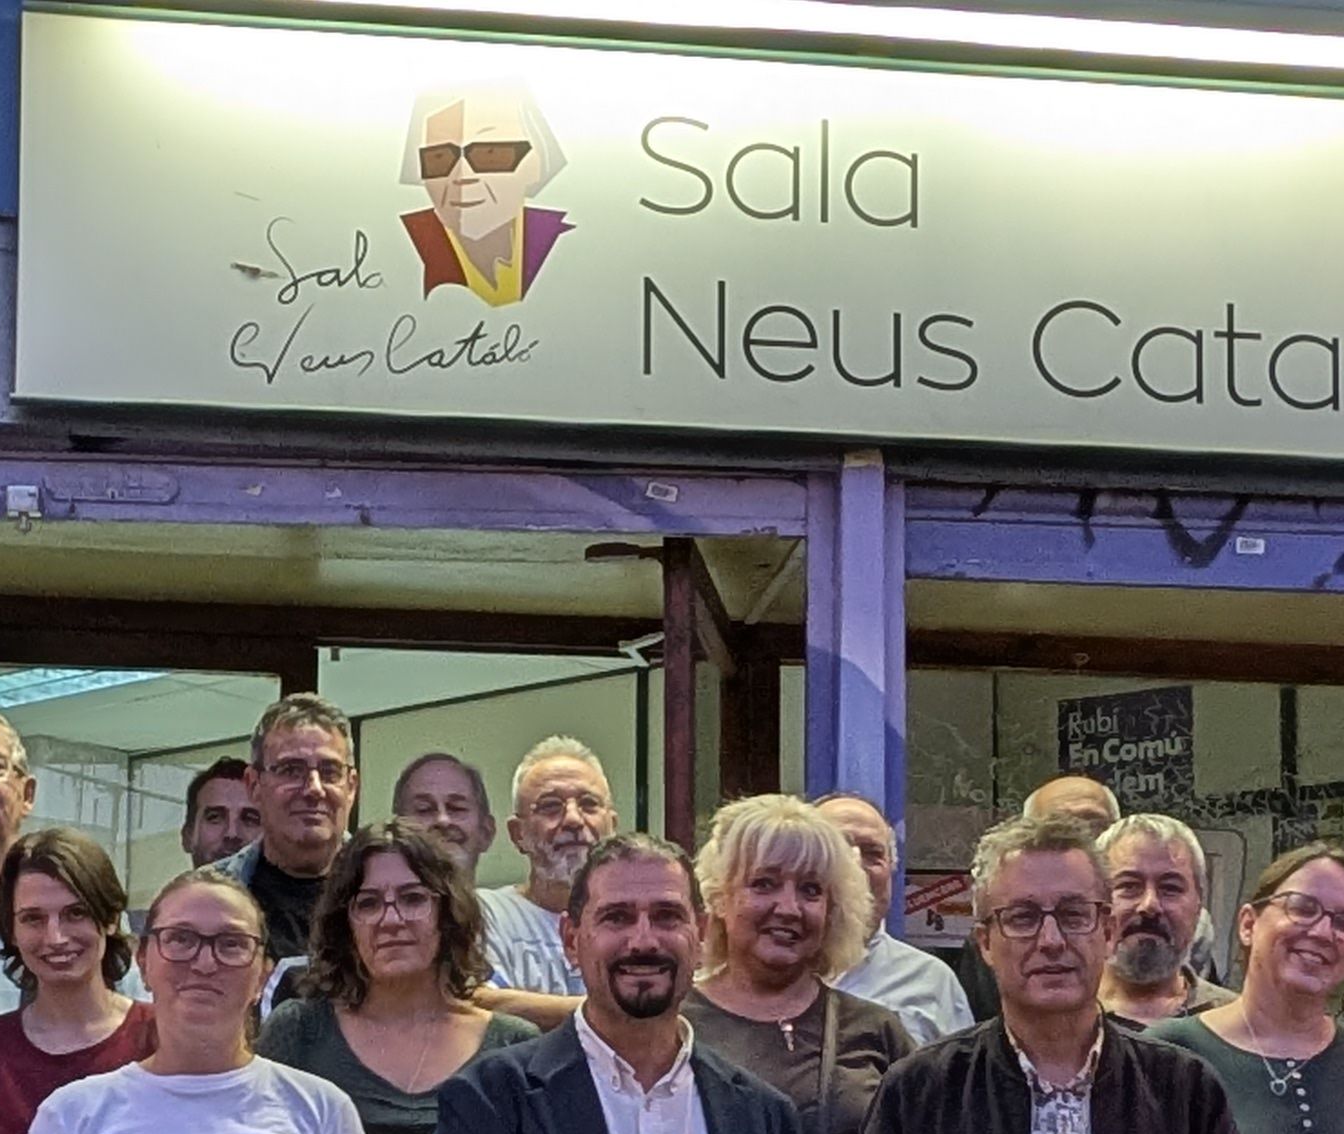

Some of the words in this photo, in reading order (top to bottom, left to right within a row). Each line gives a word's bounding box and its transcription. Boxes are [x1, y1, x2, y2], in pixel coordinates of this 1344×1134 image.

[639, 115, 920, 229] Sala
[264, 216, 387, 305] Sala
[641, 275, 979, 391] Neus
[1068, 742, 1100, 768] En
[1102, 730, 1182, 763] Comú
